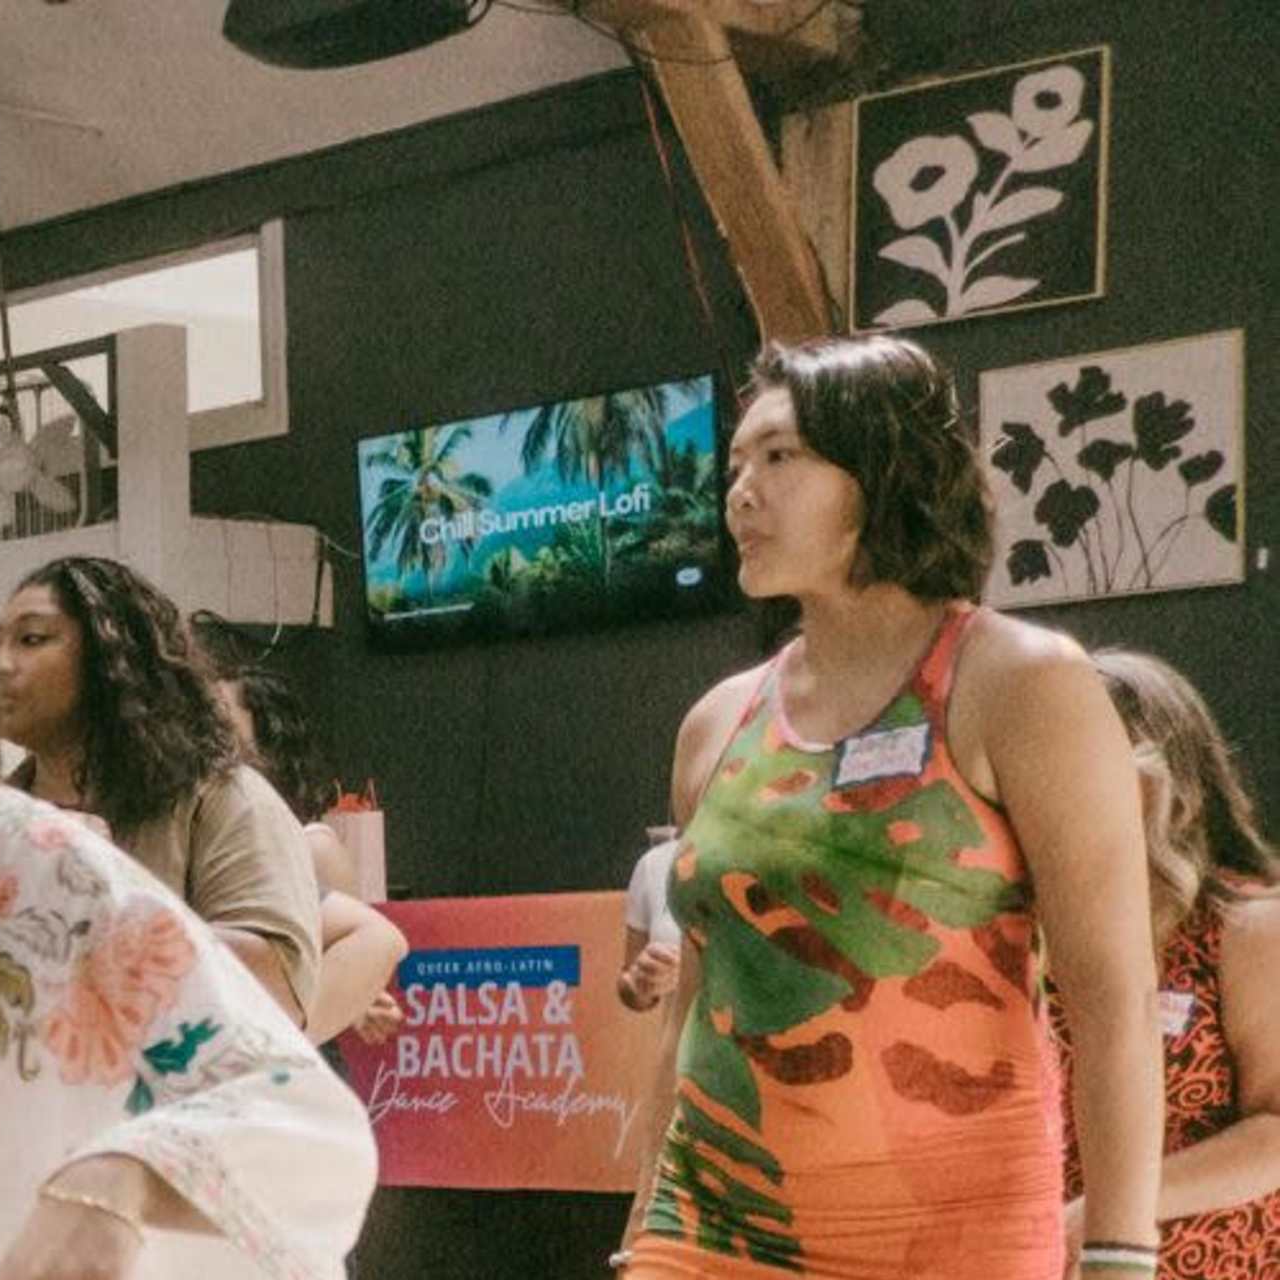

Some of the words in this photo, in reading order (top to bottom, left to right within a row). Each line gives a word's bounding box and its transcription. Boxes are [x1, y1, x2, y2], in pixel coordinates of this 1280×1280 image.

[419, 509, 474, 544] Chill
[477, 498, 595, 535] Summer
[599, 483, 651, 518] Lofi
[416, 962, 461, 976] QUEER
[466, 959, 554, 974] AFRO-LATIN
[405, 980, 529, 1026] SALSA
[543, 979, 573, 1025] &
[397, 1032, 584, 1079] BACHATA
[366, 1060, 458, 1125] Dance
[484, 1071, 639, 1159] Academy
